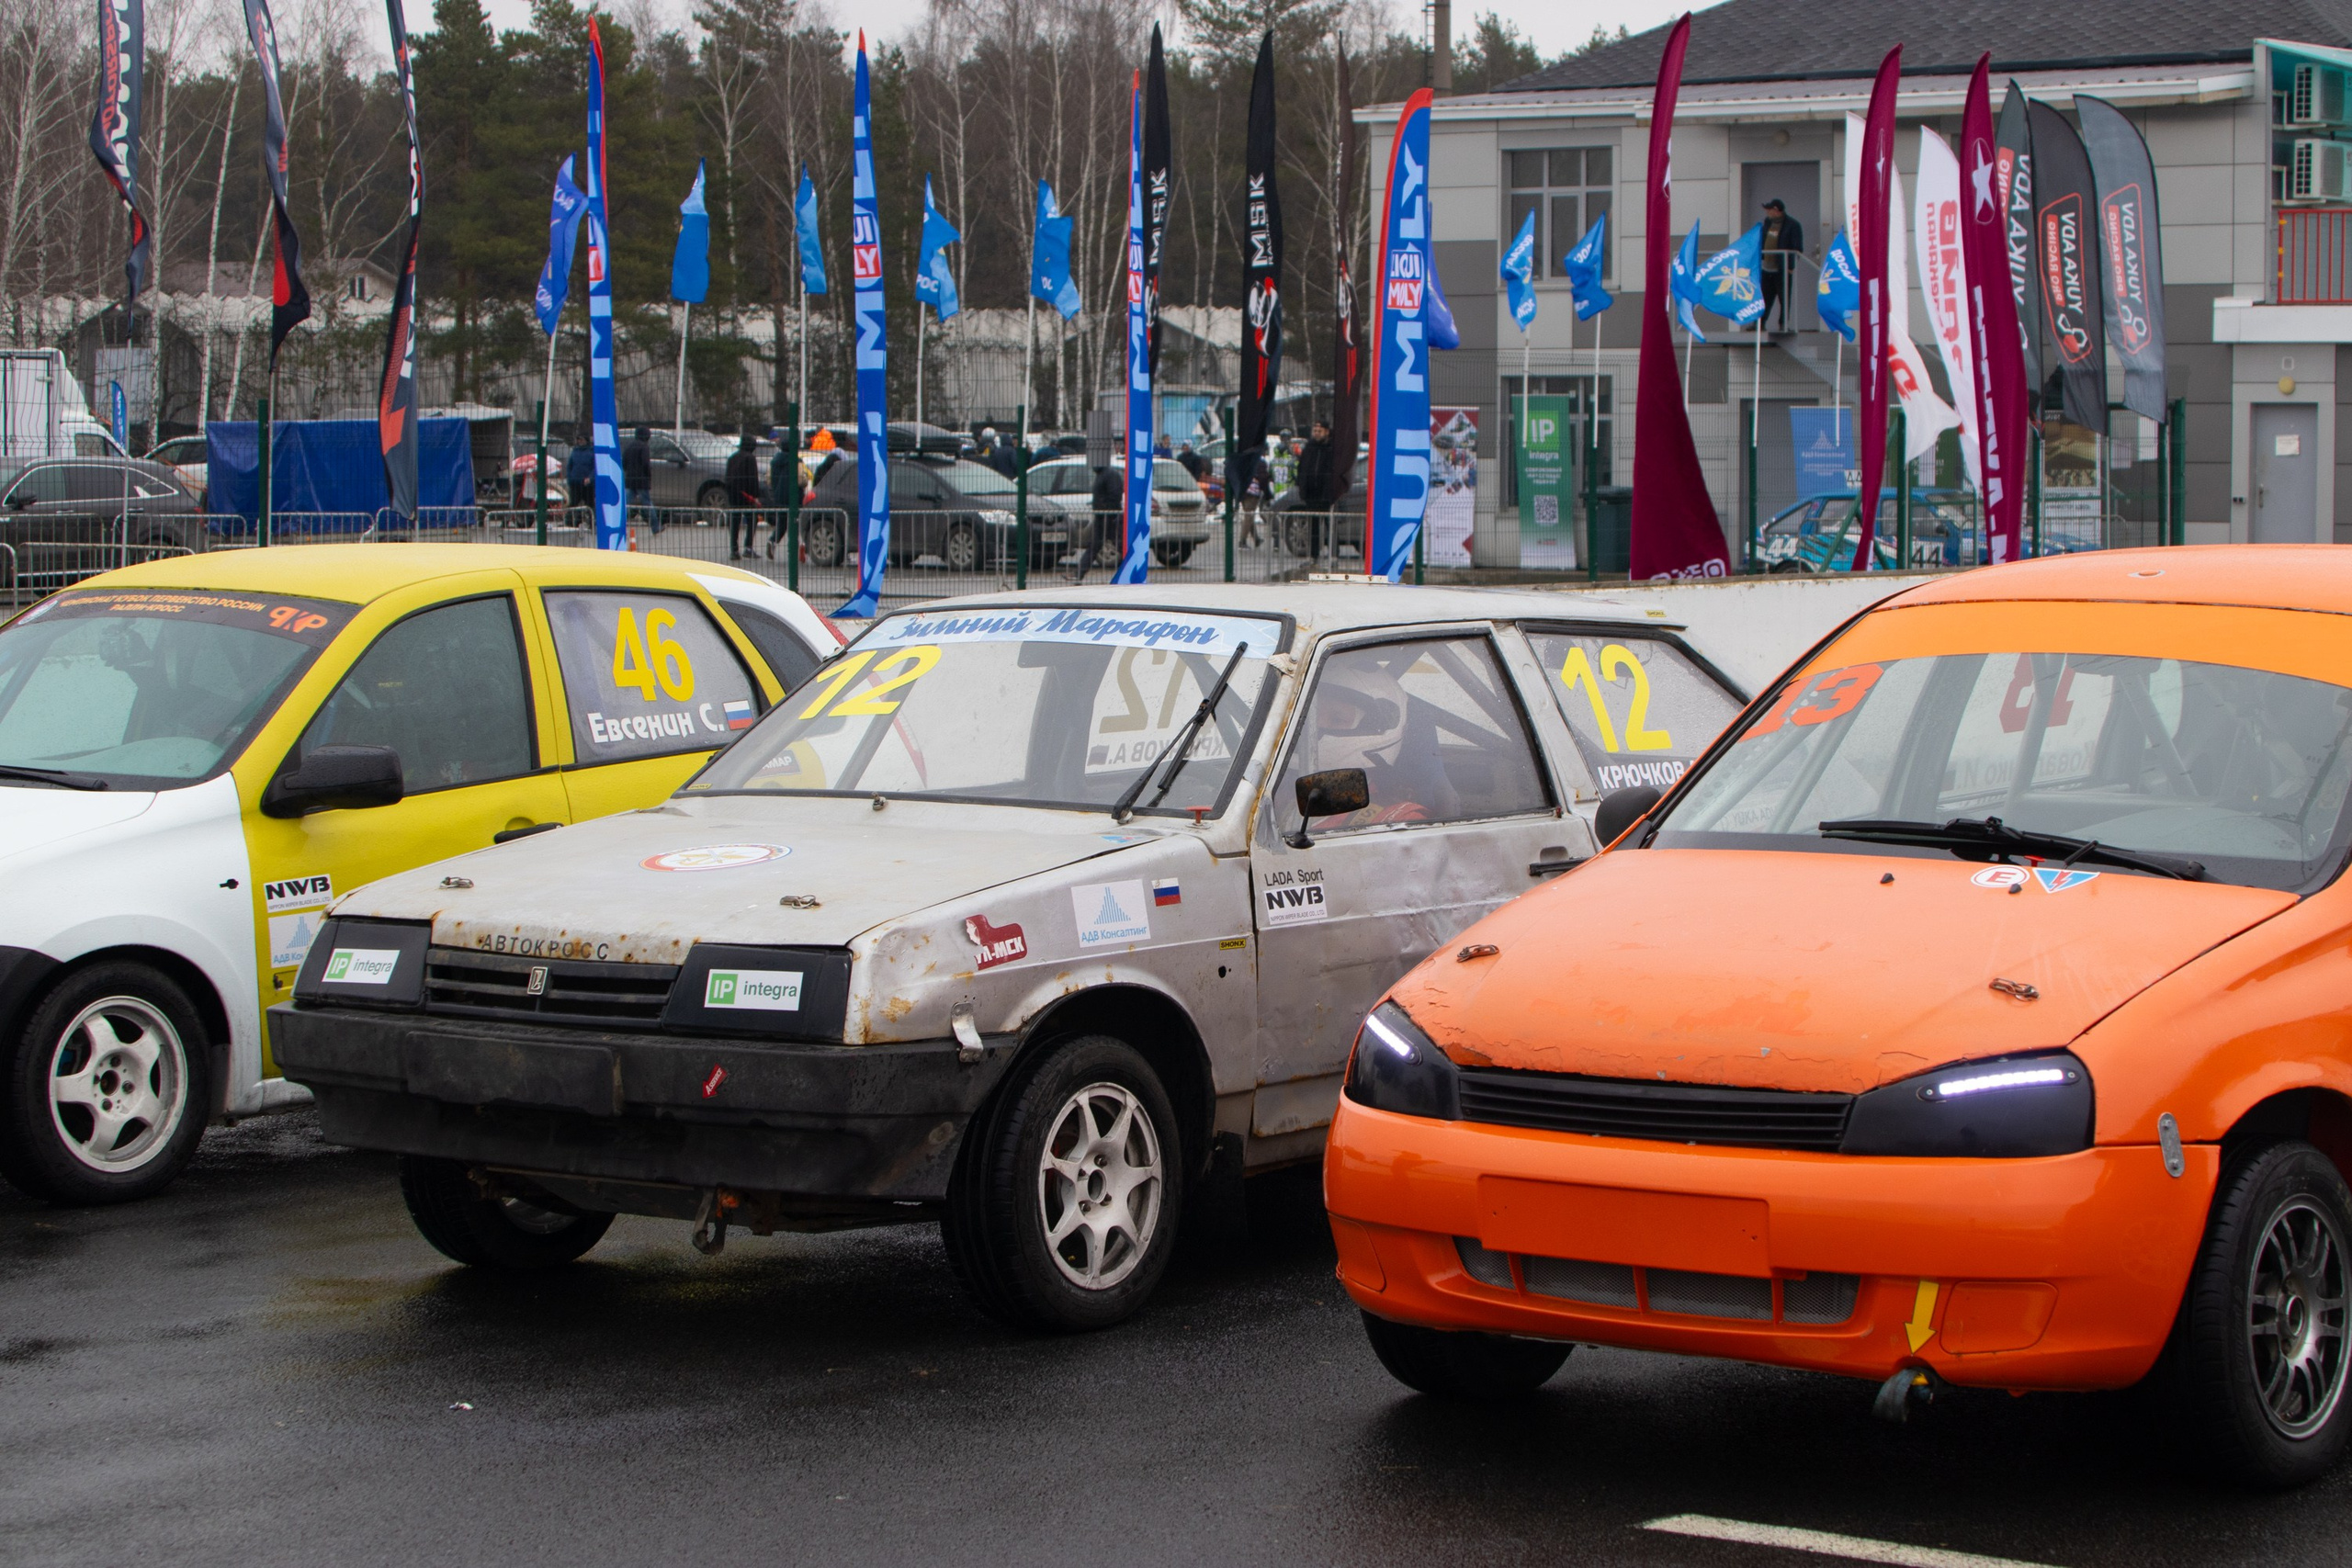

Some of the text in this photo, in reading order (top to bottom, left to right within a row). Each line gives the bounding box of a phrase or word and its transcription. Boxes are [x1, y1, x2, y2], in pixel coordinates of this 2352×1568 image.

[1250, 172, 1268, 266] MSK
[1532, 418, 1555, 443] IP
[1035, 609, 1219, 647] Марафон
[613, 607, 695, 702] 46
[797, 644, 943, 720] 12
[1561, 644, 1672, 753] 12
[1736, 663, 1883, 744] 13
[265, 876, 331, 900] NWB
[1264, 868, 1325, 886] LADA Sport
[298, 898, 312, 907] BLADE
[1265, 886, 1325, 910] NWB
[1081, 926, 1148, 942] АДВ Консалтинг
[273, 953, 291, 964] АДВ
[481, 934, 610, 960] АВТОКРОСС
[330, 957, 393, 976] IP integra
[713, 979, 797, 1000] IP integra
